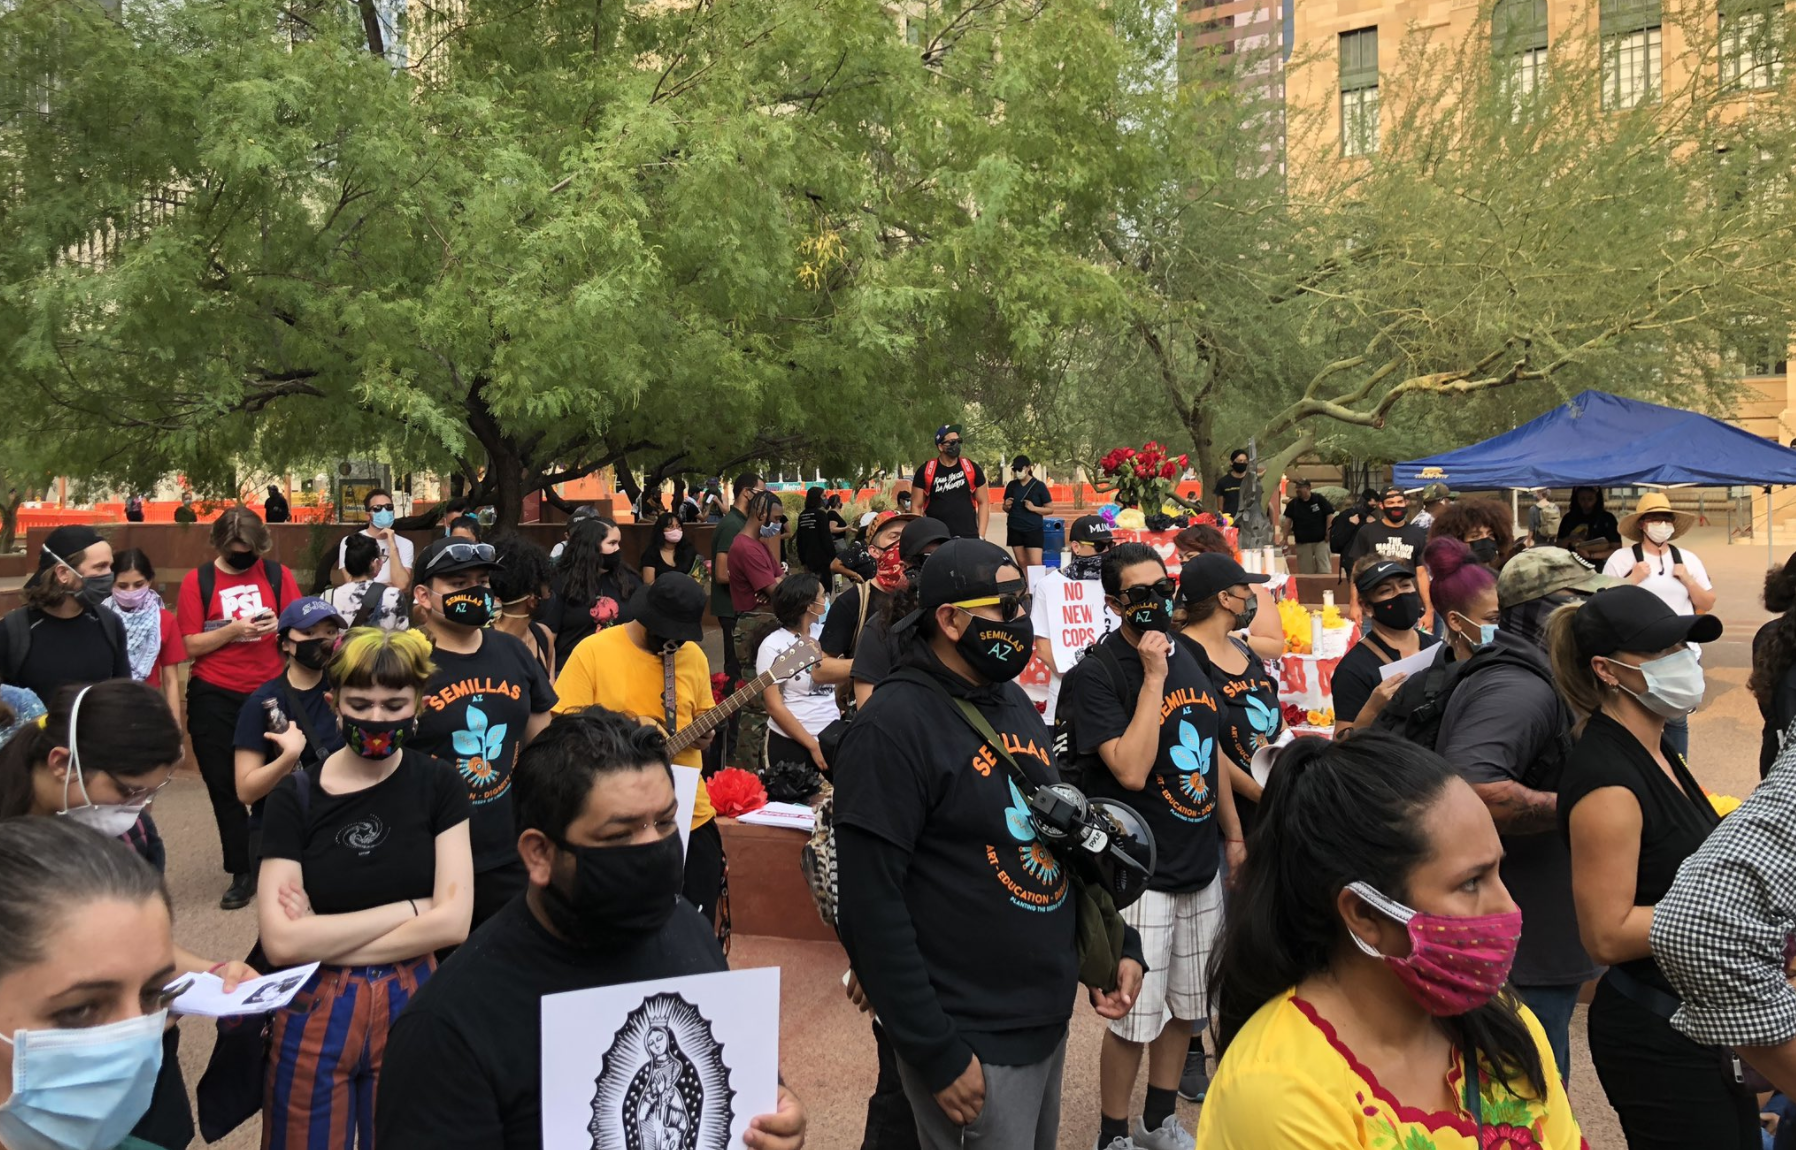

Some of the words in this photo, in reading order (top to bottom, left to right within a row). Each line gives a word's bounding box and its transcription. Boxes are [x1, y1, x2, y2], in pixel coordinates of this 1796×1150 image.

[1375, 543, 1414, 553] MARATHON
[1387, 536, 1402, 544] THE
[1063, 582, 1084, 601] NO
[221, 592, 268, 620] PSL
[445, 594, 483, 607] SEMILLAS
[456, 602, 467, 613] AZ
[1062, 604, 1092, 624] NEW
[1125, 602, 1159, 617] SEMILLAS
[1136, 610, 1152, 623] AZ
[980, 630, 1024, 653] SEMILLAS
[1062, 627, 1096, 647] COPS
[987, 642, 1013, 662] AZ
[429, 677, 521, 711] SEMILLAS
[472, 694, 484, 703] AZ
[1182, 705, 1193, 716] AZ
[1162, 789, 1198, 817] EDUCATION
[1088, 831, 1102, 848] PYLE
[986, 844, 1000, 865] ART
[997, 869, 1050, 905] EDUCATION
[1010, 896, 1037, 912] PLANTING
[1037, 905, 1046, 913] THE
